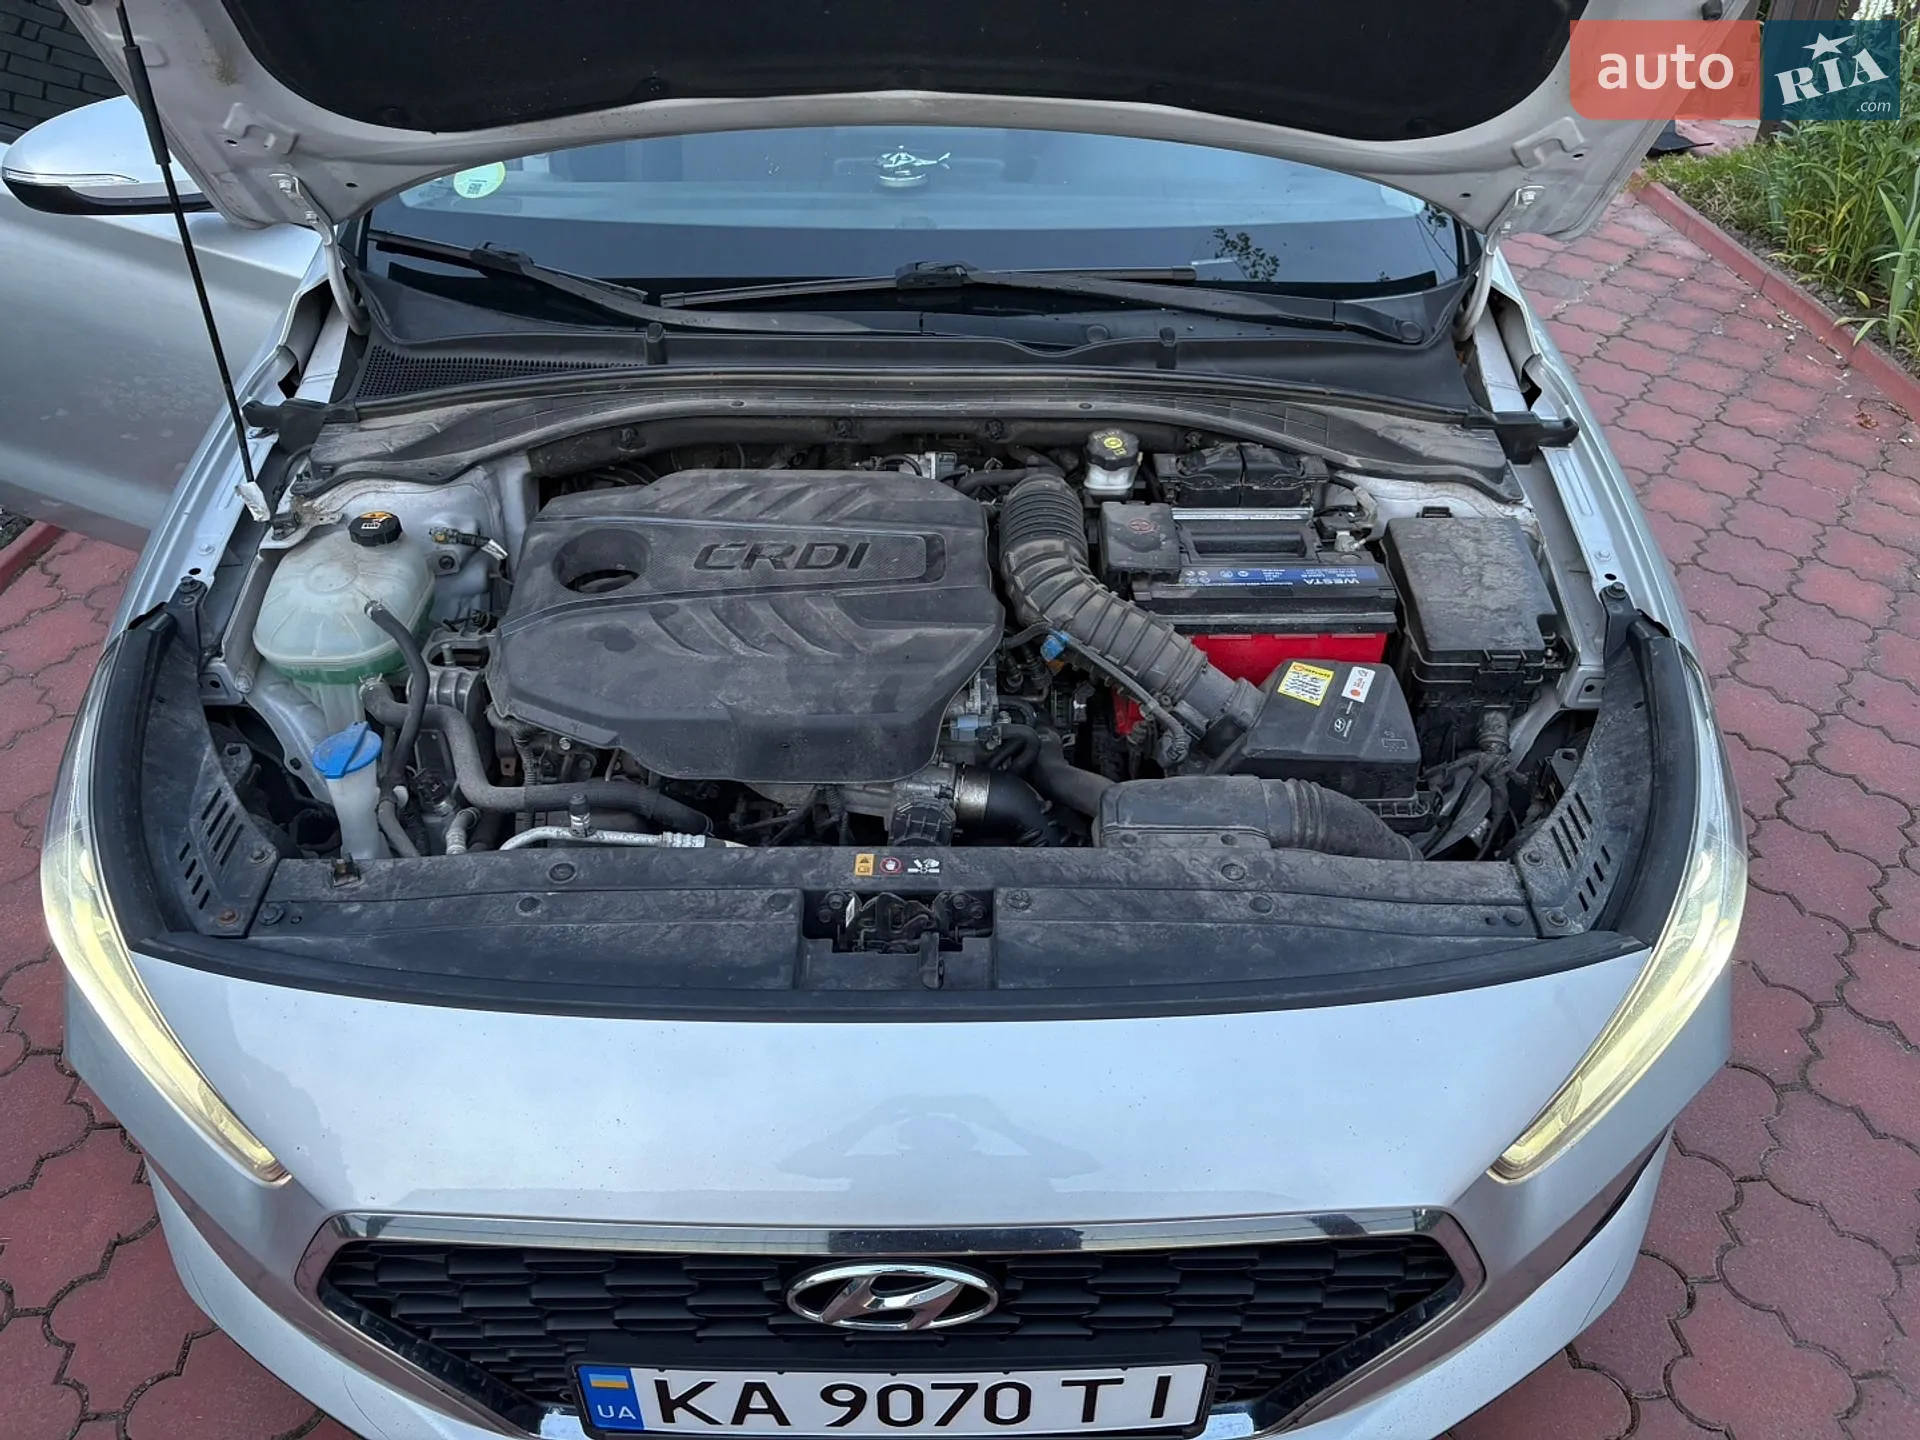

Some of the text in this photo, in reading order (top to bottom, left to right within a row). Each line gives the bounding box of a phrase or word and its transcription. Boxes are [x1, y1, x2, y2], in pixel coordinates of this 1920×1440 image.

[693, 542, 871, 571] CRDI
[1303, 577, 1360, 585] WESTA
[597, 1404, 637, 1421] UA
[654, 1375, 1172, 1428] KA 9070 TI
